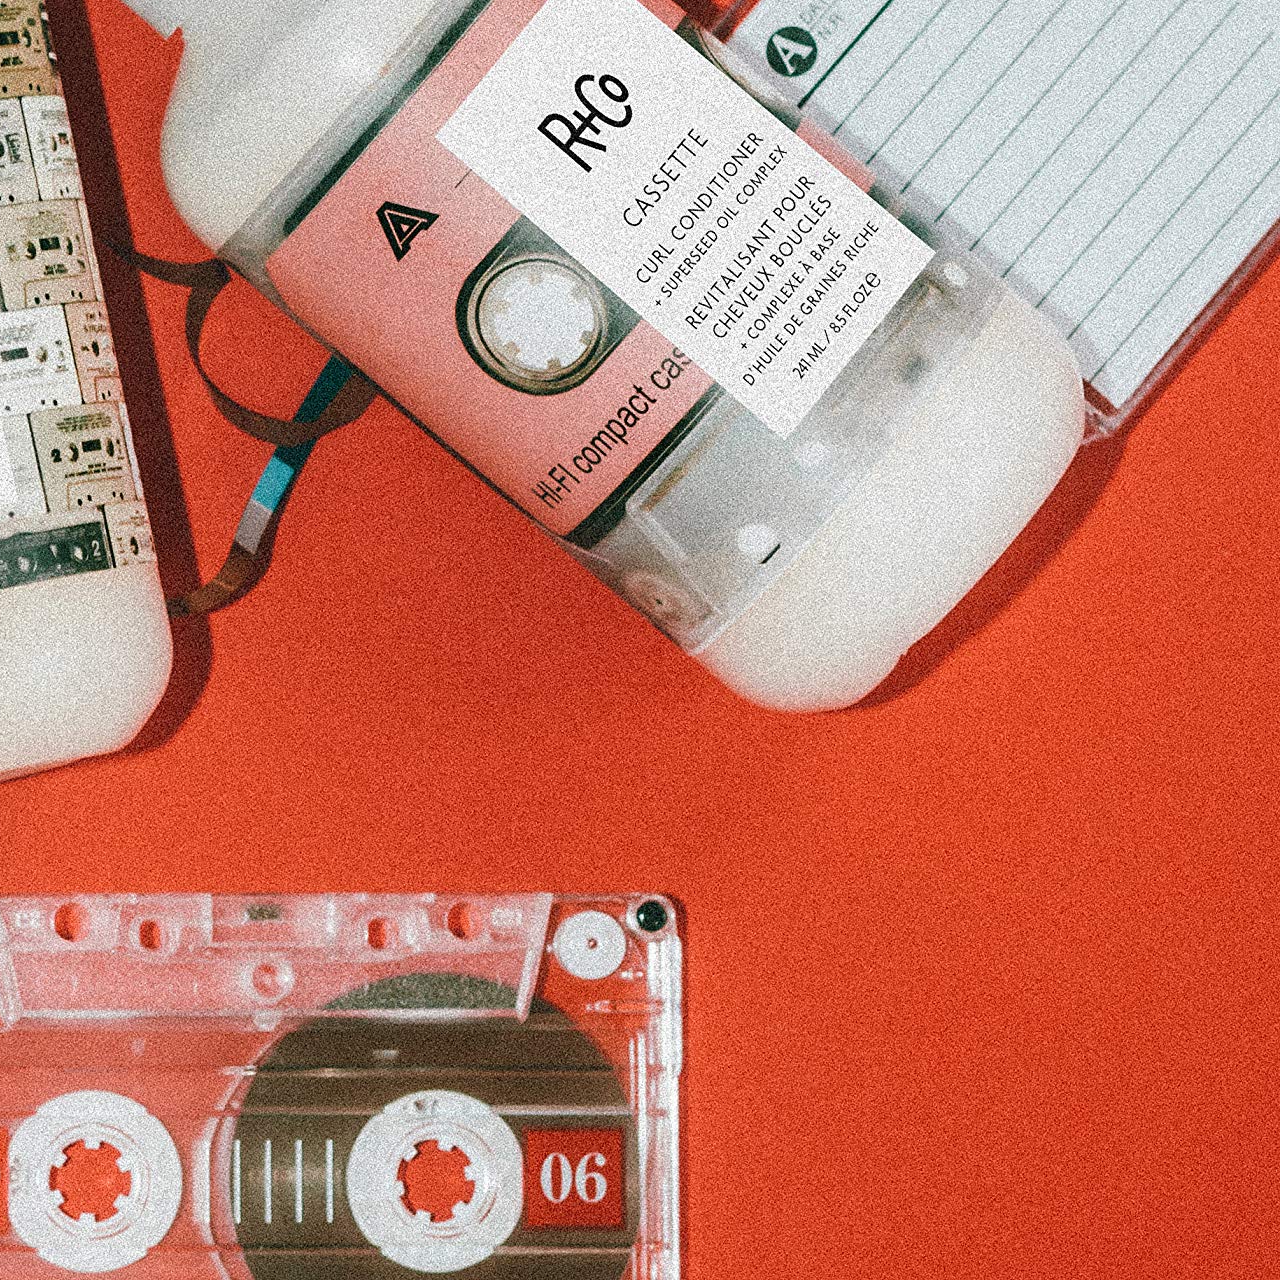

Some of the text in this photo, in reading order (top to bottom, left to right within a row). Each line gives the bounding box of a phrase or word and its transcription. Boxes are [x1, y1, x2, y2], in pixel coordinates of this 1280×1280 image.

[769, 30, 815, 76] A
[537, 73, 634, 173] R+Co
[622, 127, 710, 229] CASSETTE
[635, 130, 764, 285] CURL CONDITIONER
[660, 229, 719, 299] SUPERSEED
[718, 206, 740, 231] OIL
[735, 145, 788, 206] COMPLEX
[684, 174, 816, 331] REVITALISANT POUR
[711, 195, 833, 341] CHEVEUX BOUCLÉS
[745, 272, 806, 342] COMPLEXE
[810, 227, 842, 261] BASE
[781, 317, 799, 338] DE
[798, 260, 848, 317] GRAINES
[844, 220, 880, 261] RICHE
[792, 357, 812, 380] 241
[808, 339, 829, 366] ML
[832, 313, 849, 335] 8.5
[531, 462, 581, 510] HI-FI
[572, 384, 657, 474] compact
[540, 1152, 608, 1204] 90
